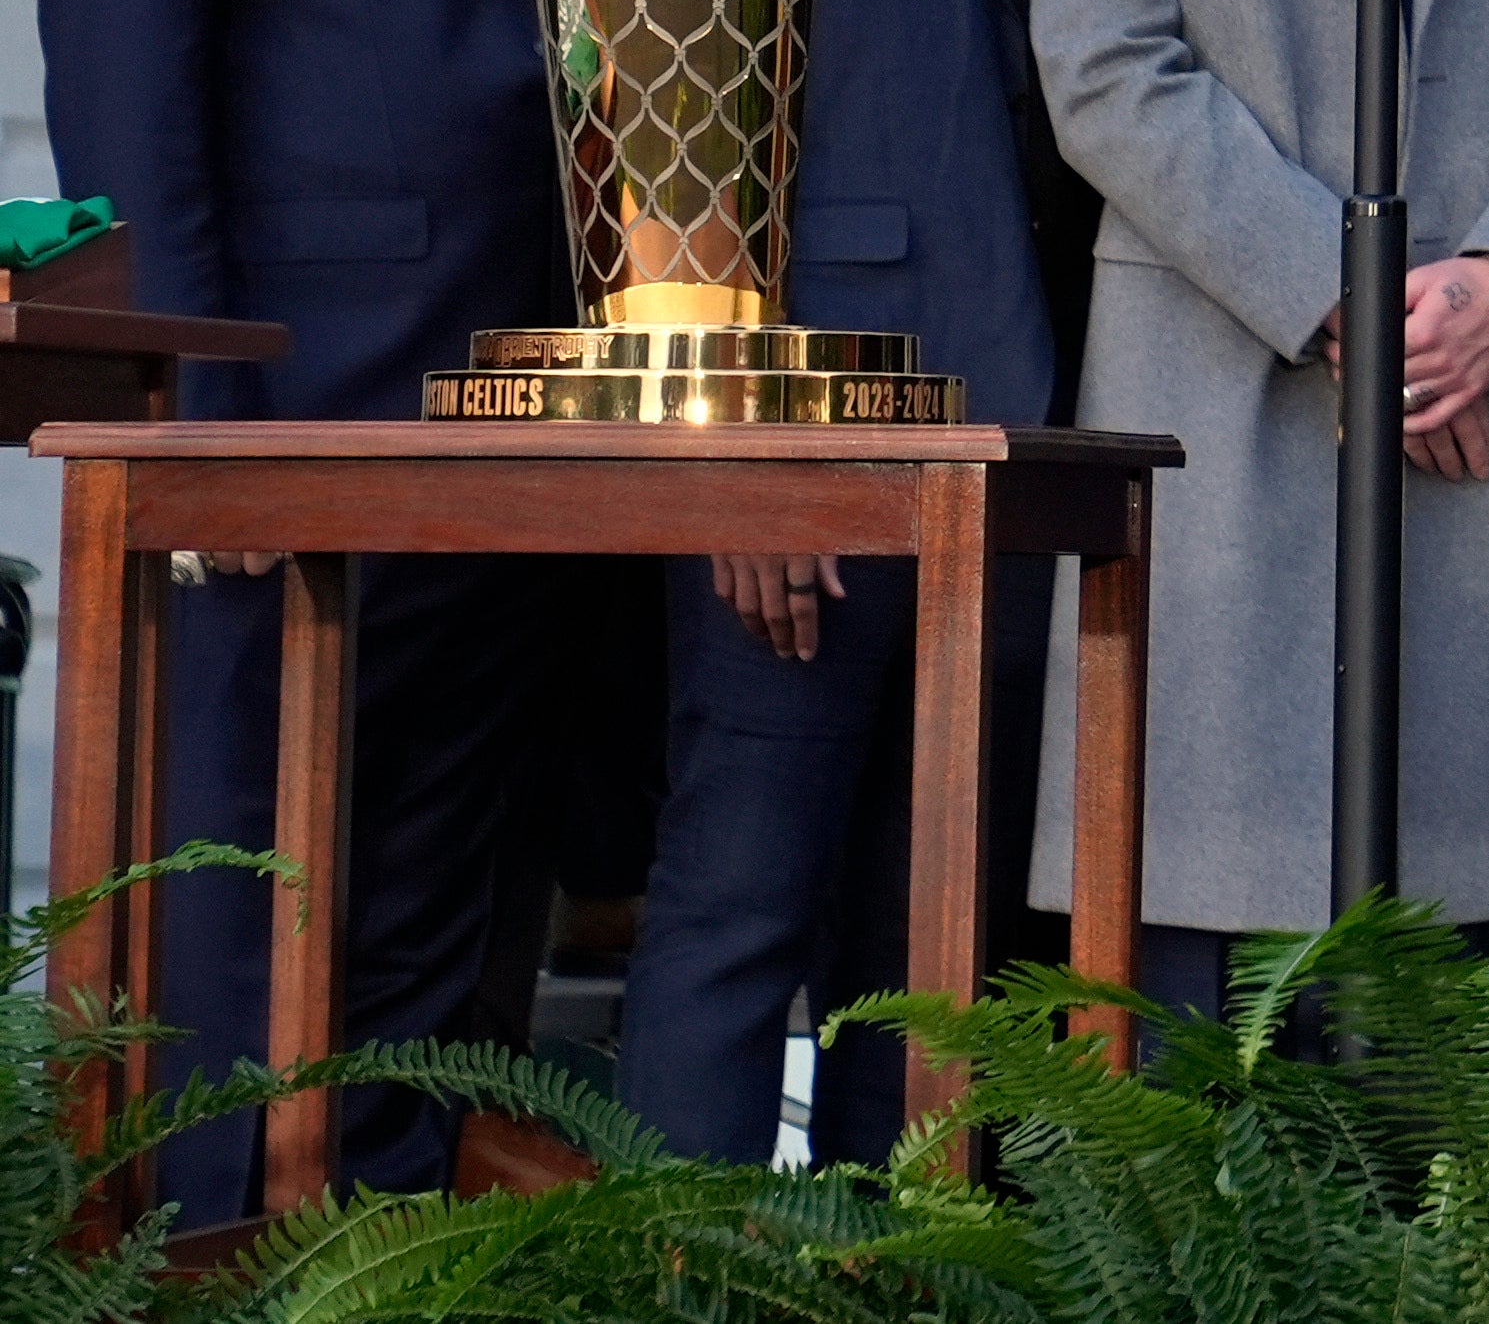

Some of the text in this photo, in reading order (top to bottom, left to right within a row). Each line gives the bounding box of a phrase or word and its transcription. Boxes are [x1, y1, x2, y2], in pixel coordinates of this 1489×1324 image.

[541, 335, 615, 368] TROPHY
[428, 378, 544, 416] STON CELTICS
[842, 381, 939, 420] 2023-2024
